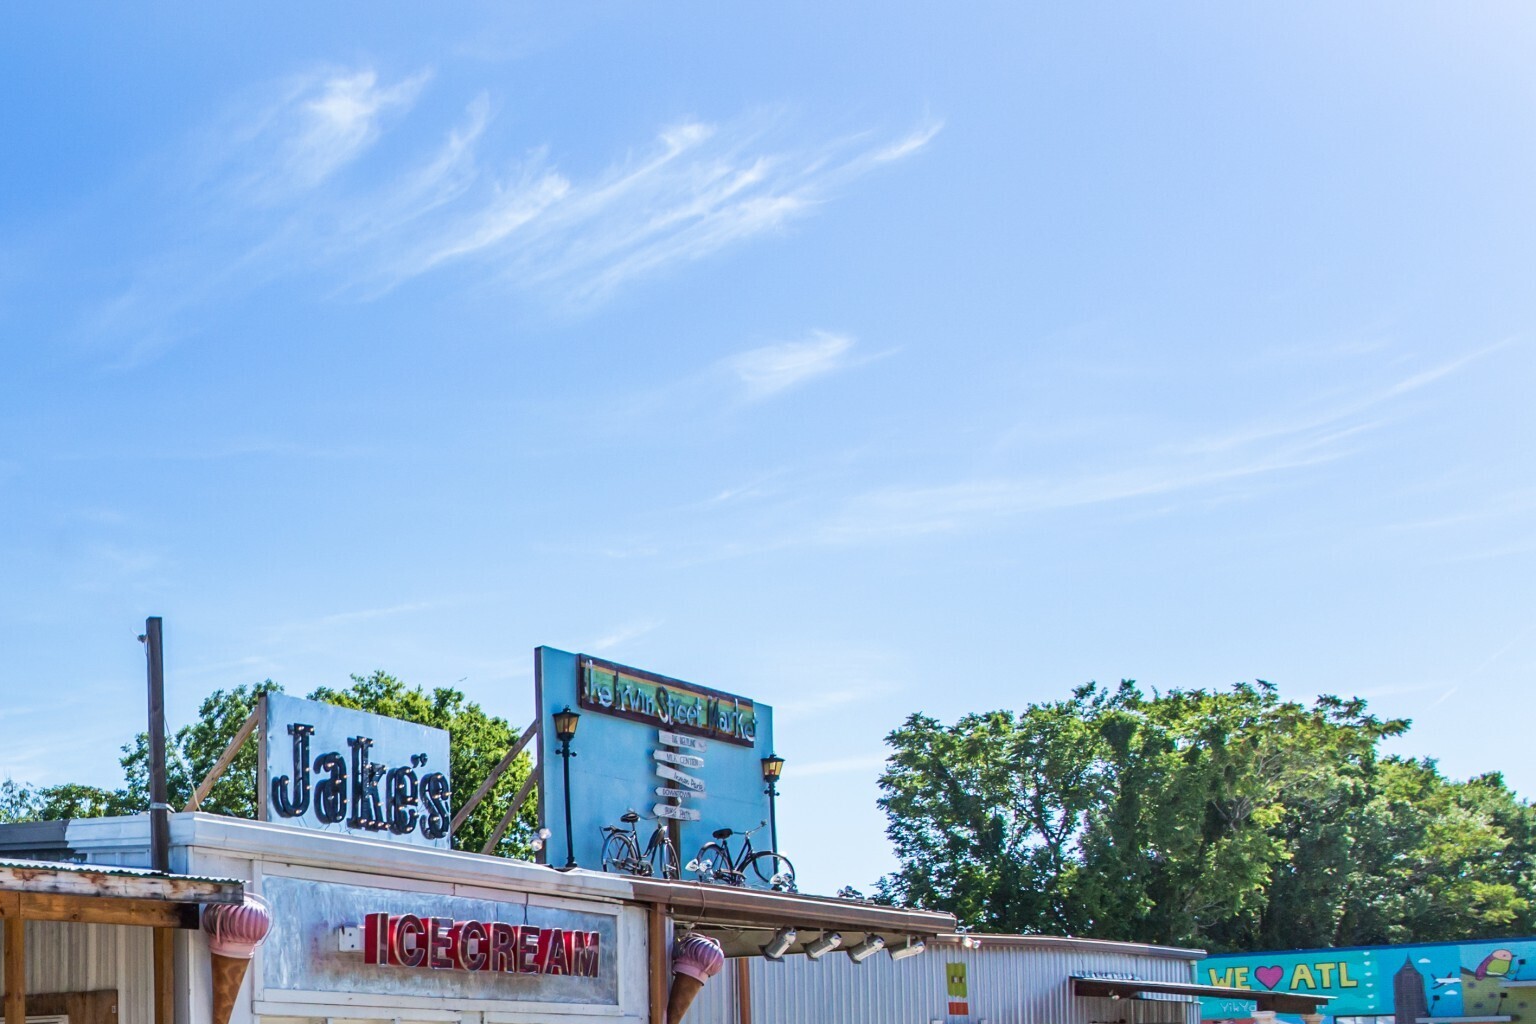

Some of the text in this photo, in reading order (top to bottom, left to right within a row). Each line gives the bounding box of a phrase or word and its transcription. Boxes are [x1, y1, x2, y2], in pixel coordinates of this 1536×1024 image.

[584, 660, 759, 742] The Irwin Street Market
[271, 723, 452, 840] Jake's
[1208, 962, 1359, 990] WE ATL
[1220, 1003, 1258, 1013] YikYa
